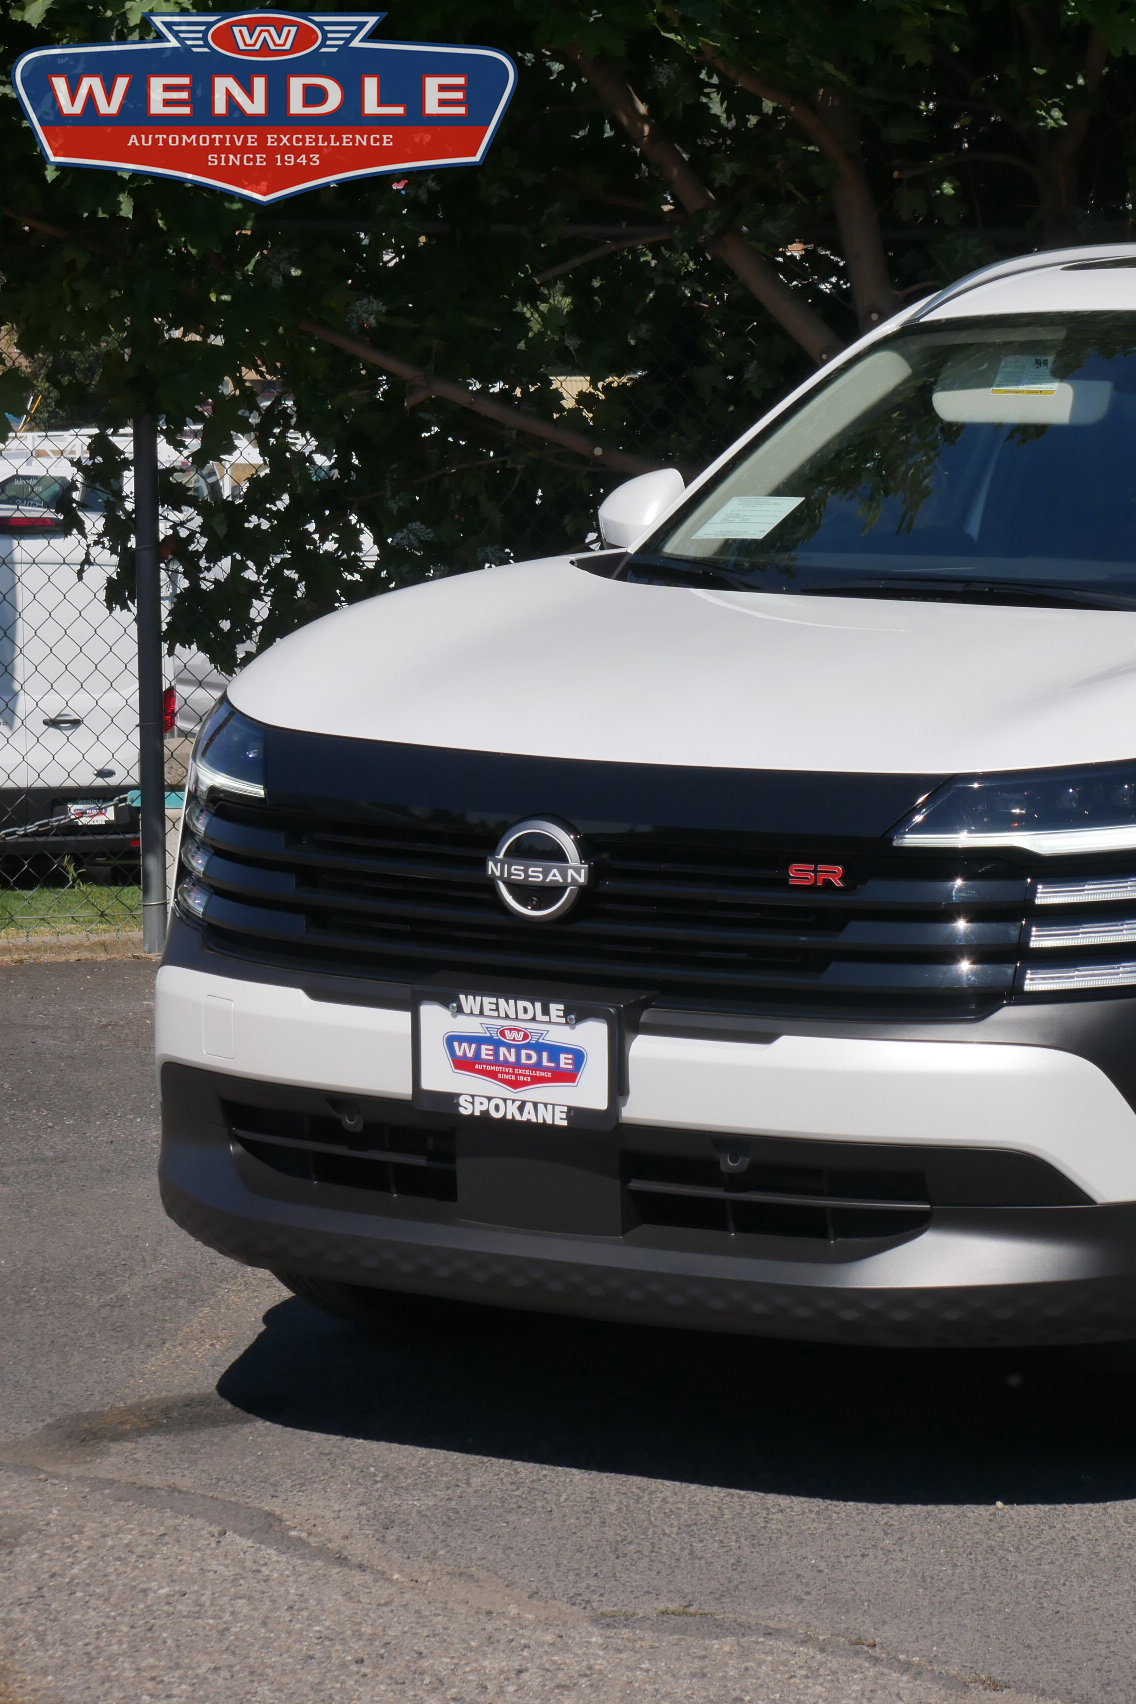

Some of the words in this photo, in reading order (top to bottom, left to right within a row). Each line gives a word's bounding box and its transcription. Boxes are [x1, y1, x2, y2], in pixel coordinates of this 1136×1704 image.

[487, 860, 586, 885] NISSAN
[788, 863, 844, 888] SR
[459, 995, 566, 1023] WENDLE
[454, 1042, 574, 1068] WENDLE
[475, 1063, 514, 1075] AUTOMOTIVE
[514, 1068, 552, 1078] EXCELLENCE
[497, 1073, 516, 1081] SINCE
[459, 1095, 567, 1126] SPOKANE
